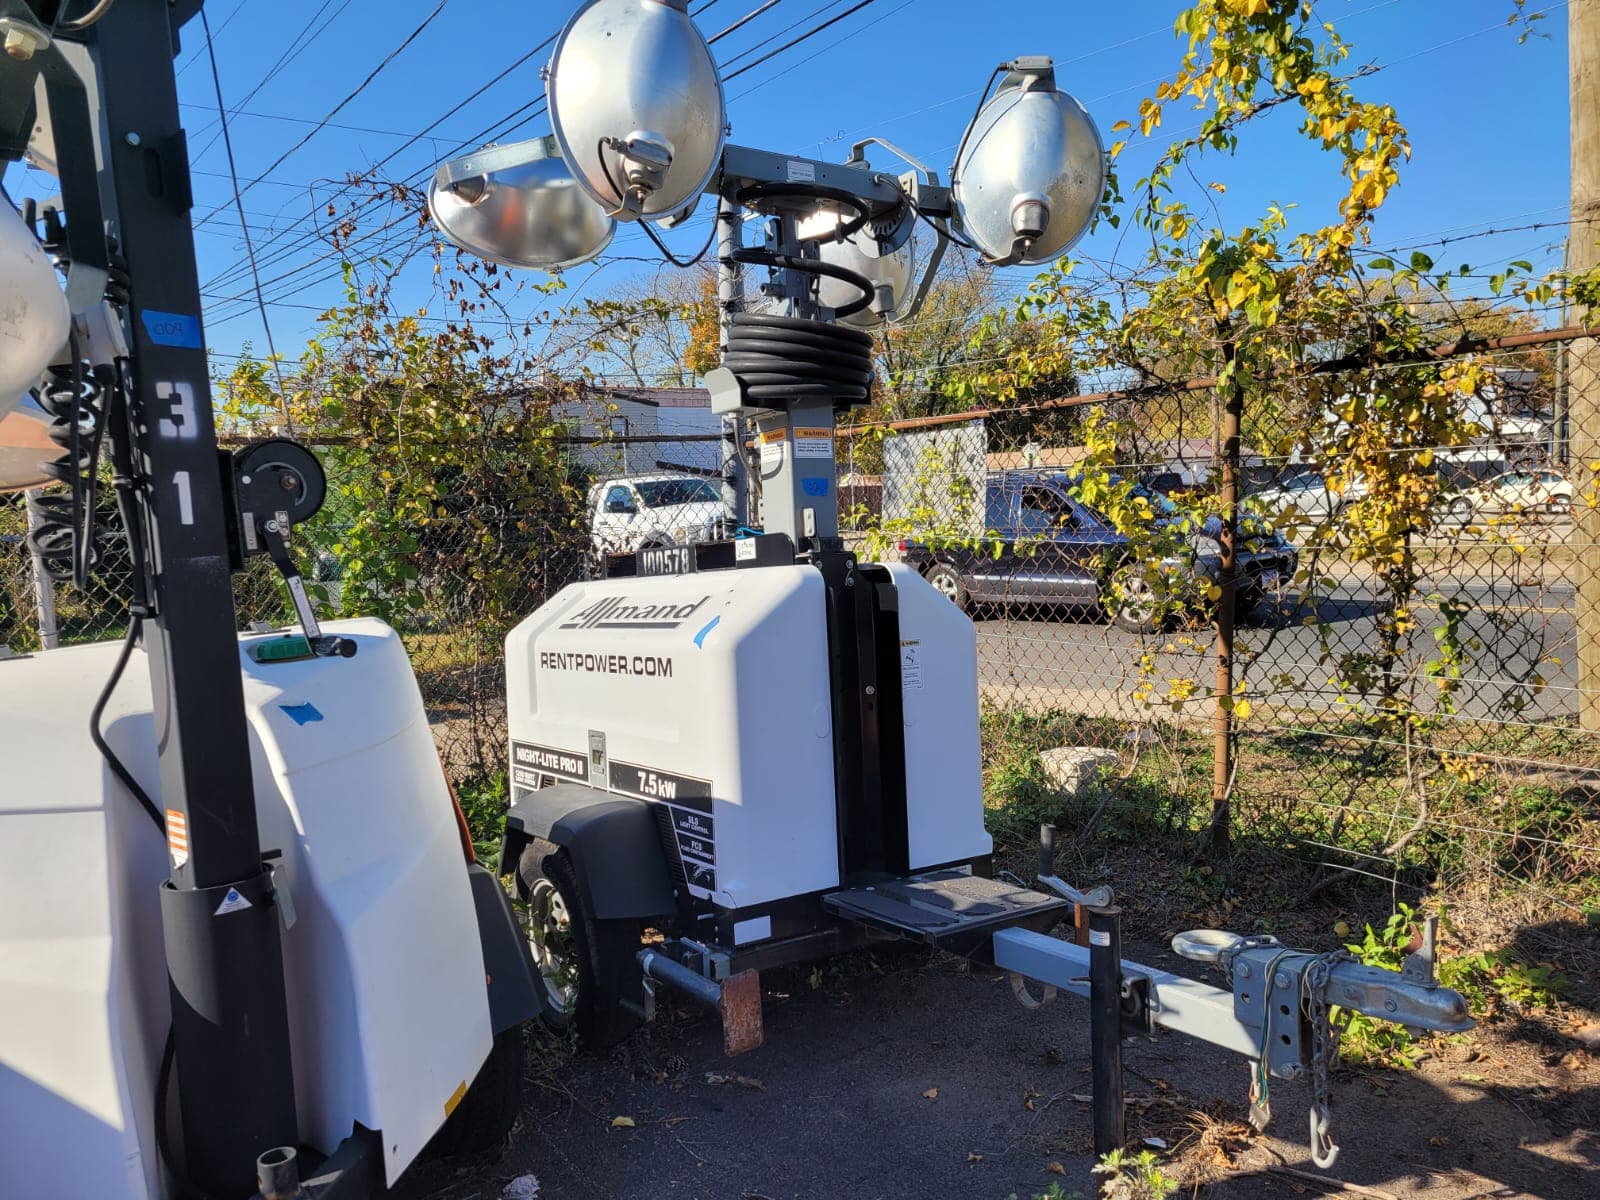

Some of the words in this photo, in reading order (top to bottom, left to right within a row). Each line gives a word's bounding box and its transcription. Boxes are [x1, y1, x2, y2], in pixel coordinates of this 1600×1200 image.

[155, 381, 197, 438] 3
[172, 471, 194, 525] 1
[643, 548, 690, 575] 100578
[569, 596, 711, 628] Allmand
[540, 652, 673, 678] RENTPOWER.COM
[516, 747, 560, 769] NIGHT-LITE
[560, 757, 577, 773] PRO
[637, 770, 658, 795] 7.5
[658, 778, 676, 799] kW
